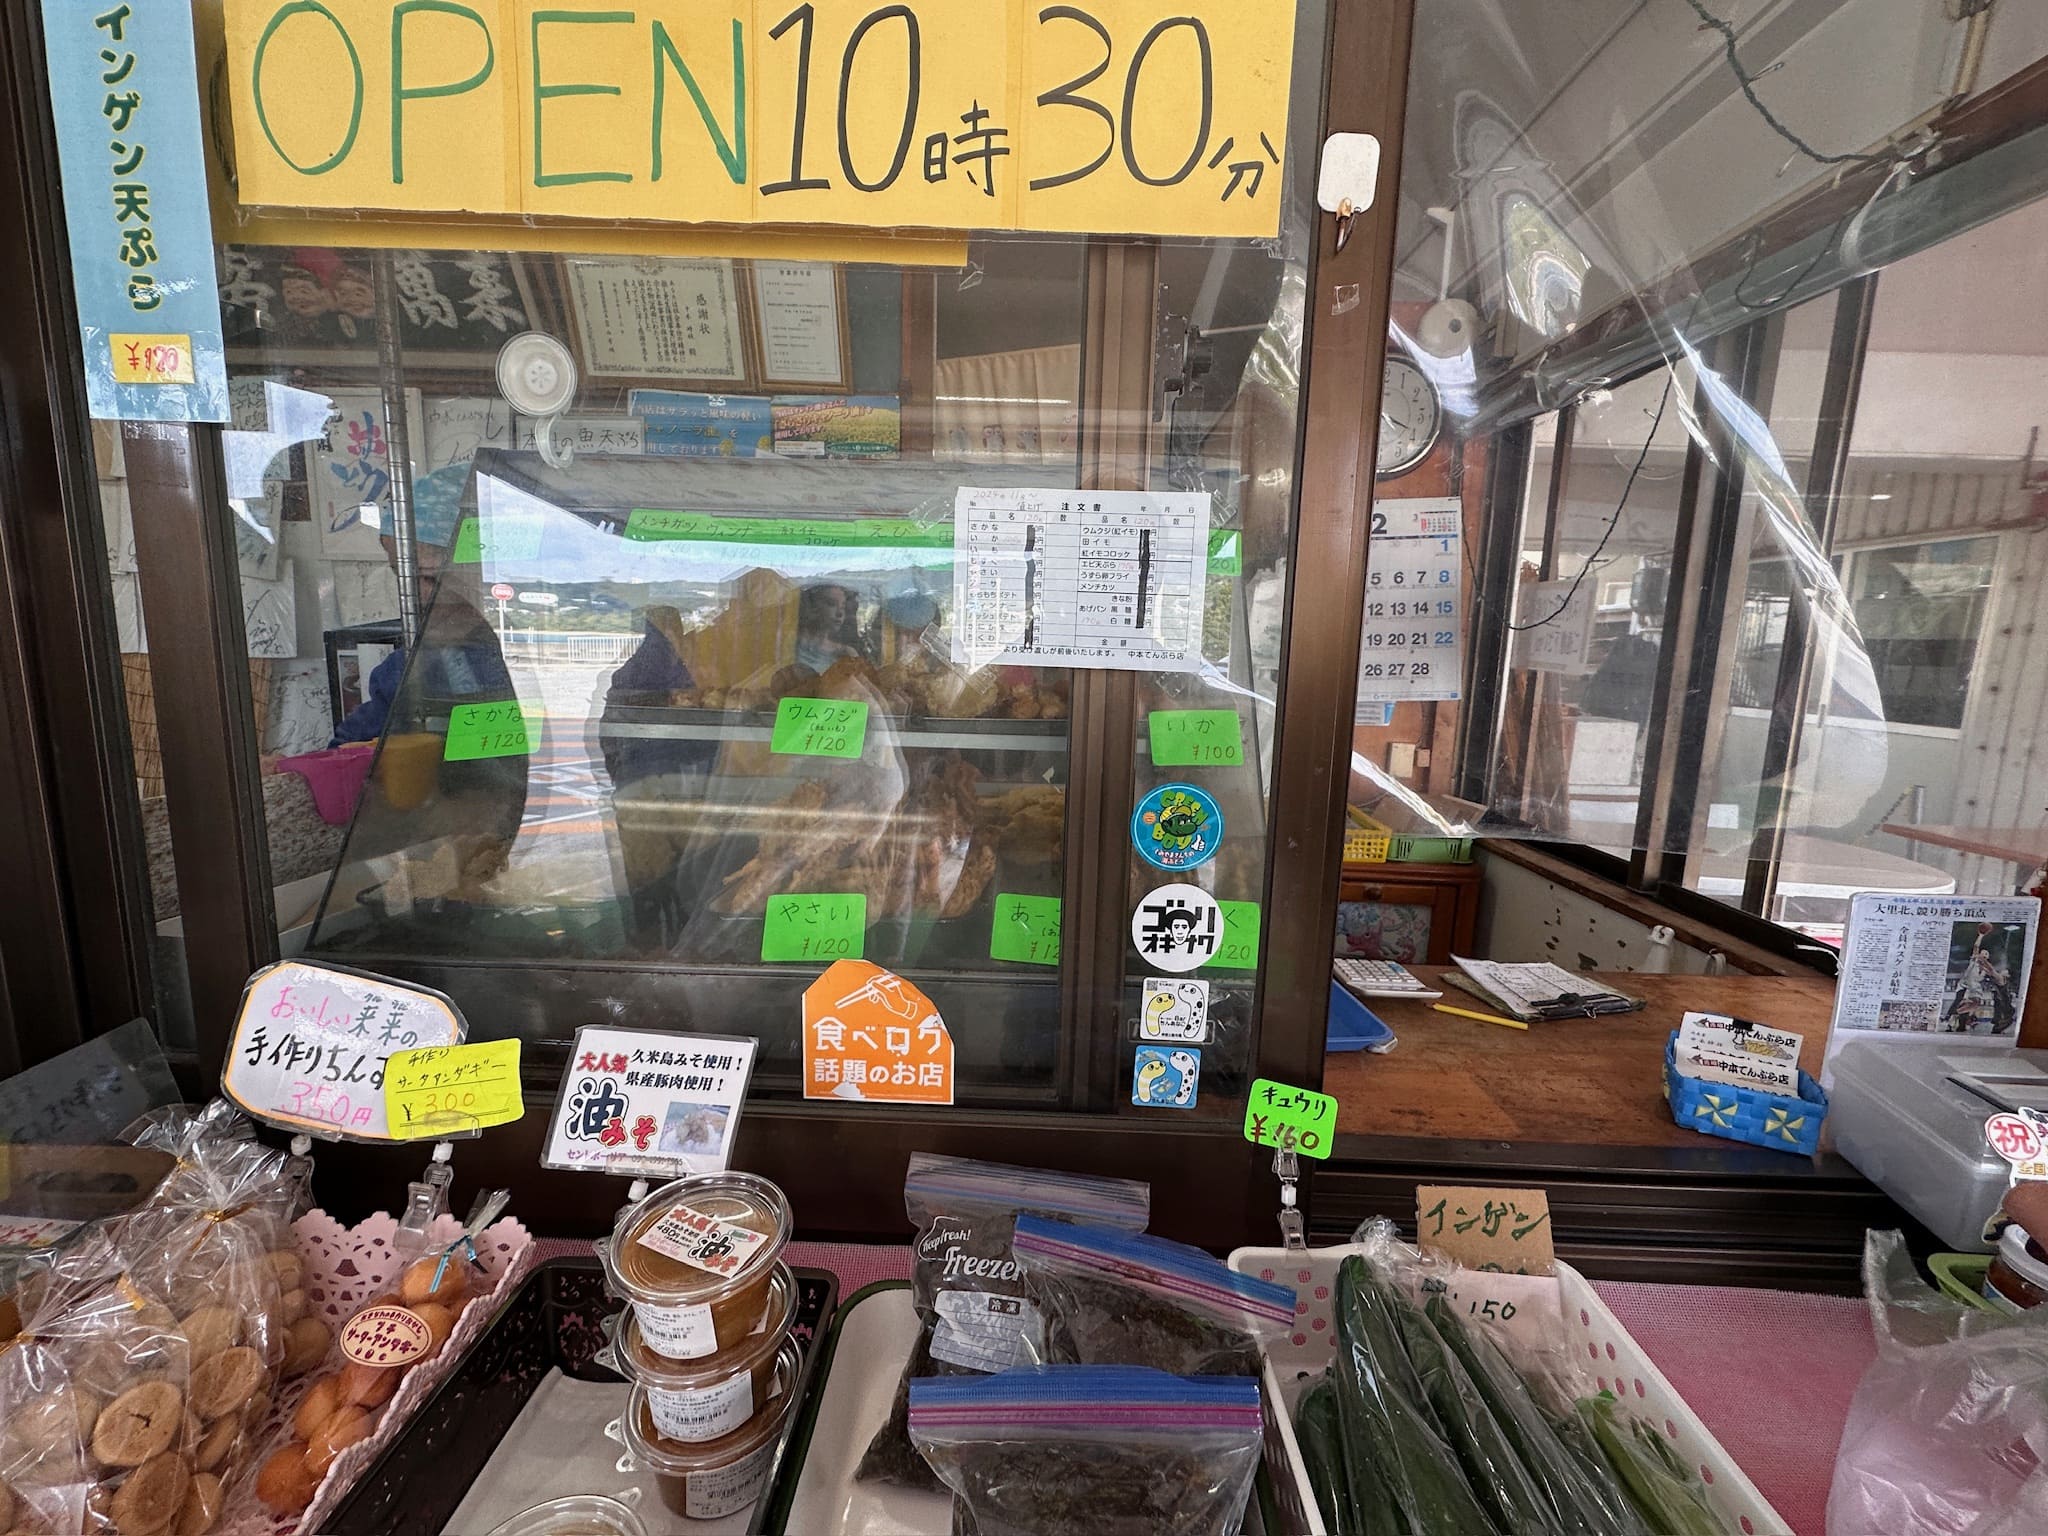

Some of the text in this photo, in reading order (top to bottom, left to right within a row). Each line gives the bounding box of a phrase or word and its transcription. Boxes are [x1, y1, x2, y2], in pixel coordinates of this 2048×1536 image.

[253, 0, 1281, 202] OPEN 10時30分
[95, 3, 160, 312] インゲン天ぷら
[696, 293, 711, 335] 感謝状
[522, 426, 640, 449] 本の魚天ぷら
[1371, 512, 1388, 535] 2
[1440, 539, 1449, 552] 1
[1080, 583, 1116, 591] メンチカツ
[1370, 570, 1450, 585] 5 6 7 8
[1367, 600, 1453, 616] 12 13 14 15
[1366, 631, 1454, 646] 19 20 21 22
[1364, 662, 1430, 677] 26 27 28
[463, 705, 523, 726] さかな
[788, 703, 858, 723] ウムクジ
[1167, 719, 1216, 734] いか
[804, 734, 847, 751] ¥120
[1192, 744, 1236, 760] ¥100
[780, 901, 850, 924] やさい
[801, 937, 850, 957] ¥120
[271, 984, 351, 1029] おいしい
[407, 1048, 450, 1066] 手作り
[576, 1051, 631, 1074] 大人気
[813, 1058, 945, 1087] 話題のお店
[280, 1080, 373, 1127] 350円
[1261, 1086, 1327, 1121] キュウリ
[1993, 1120, 2036, 1154] 祝
[1423, 1198, 1550, 1242] インゲン
